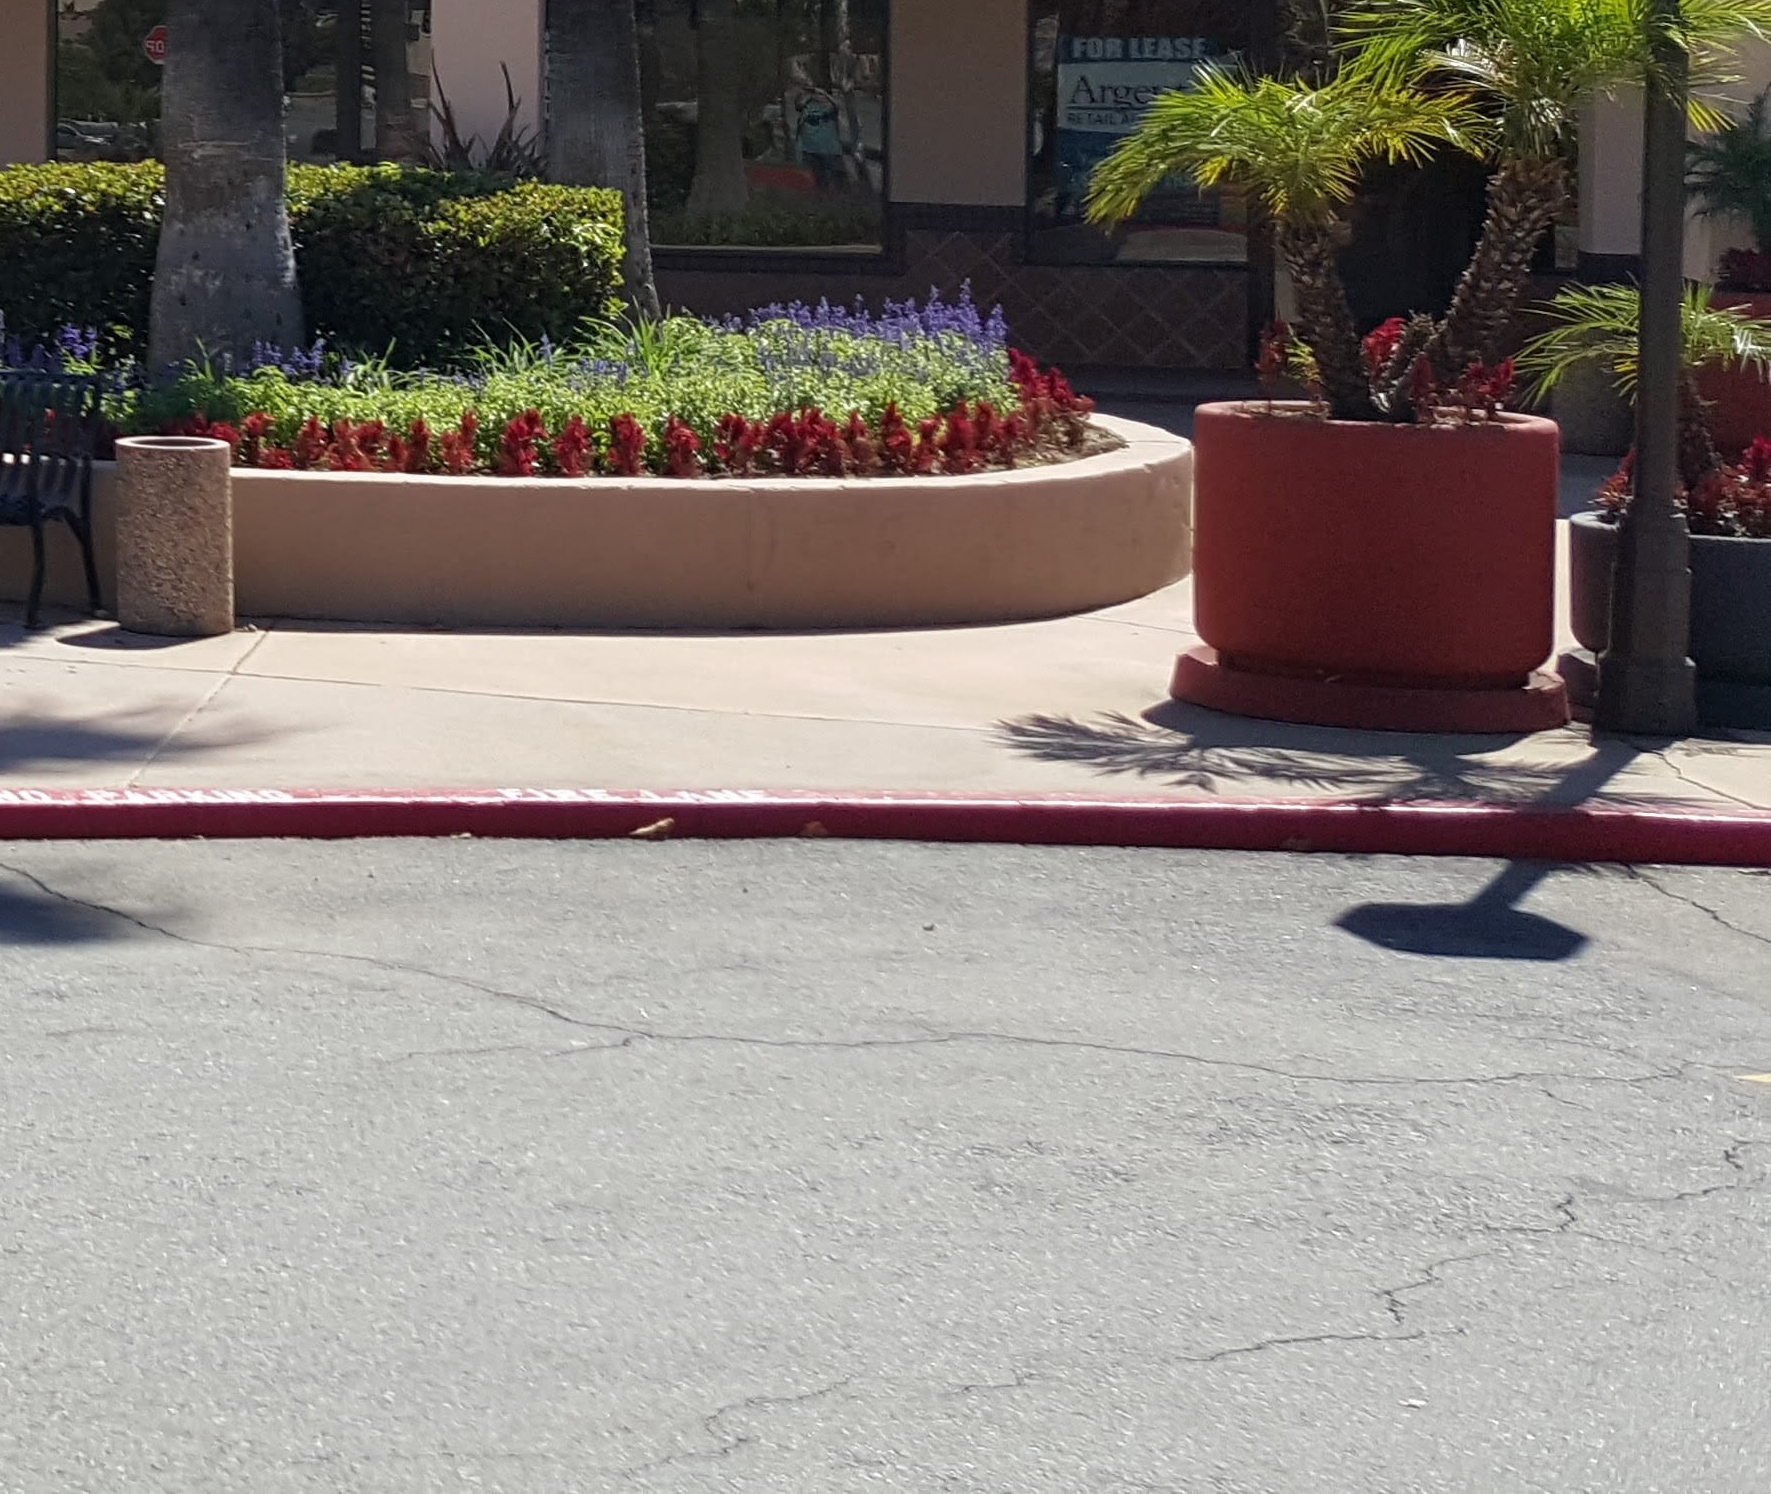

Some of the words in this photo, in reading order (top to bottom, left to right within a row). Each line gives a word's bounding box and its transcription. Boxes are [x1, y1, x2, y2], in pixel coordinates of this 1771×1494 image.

[1072, 37, 1123, 59] FOR
[1130, 38, 1207, 59] LEASE
[1071, 75, 1188, 109] Arge
[81, 788, 294, 804] PARKING
[496, 787, 623, 802] FIRE
